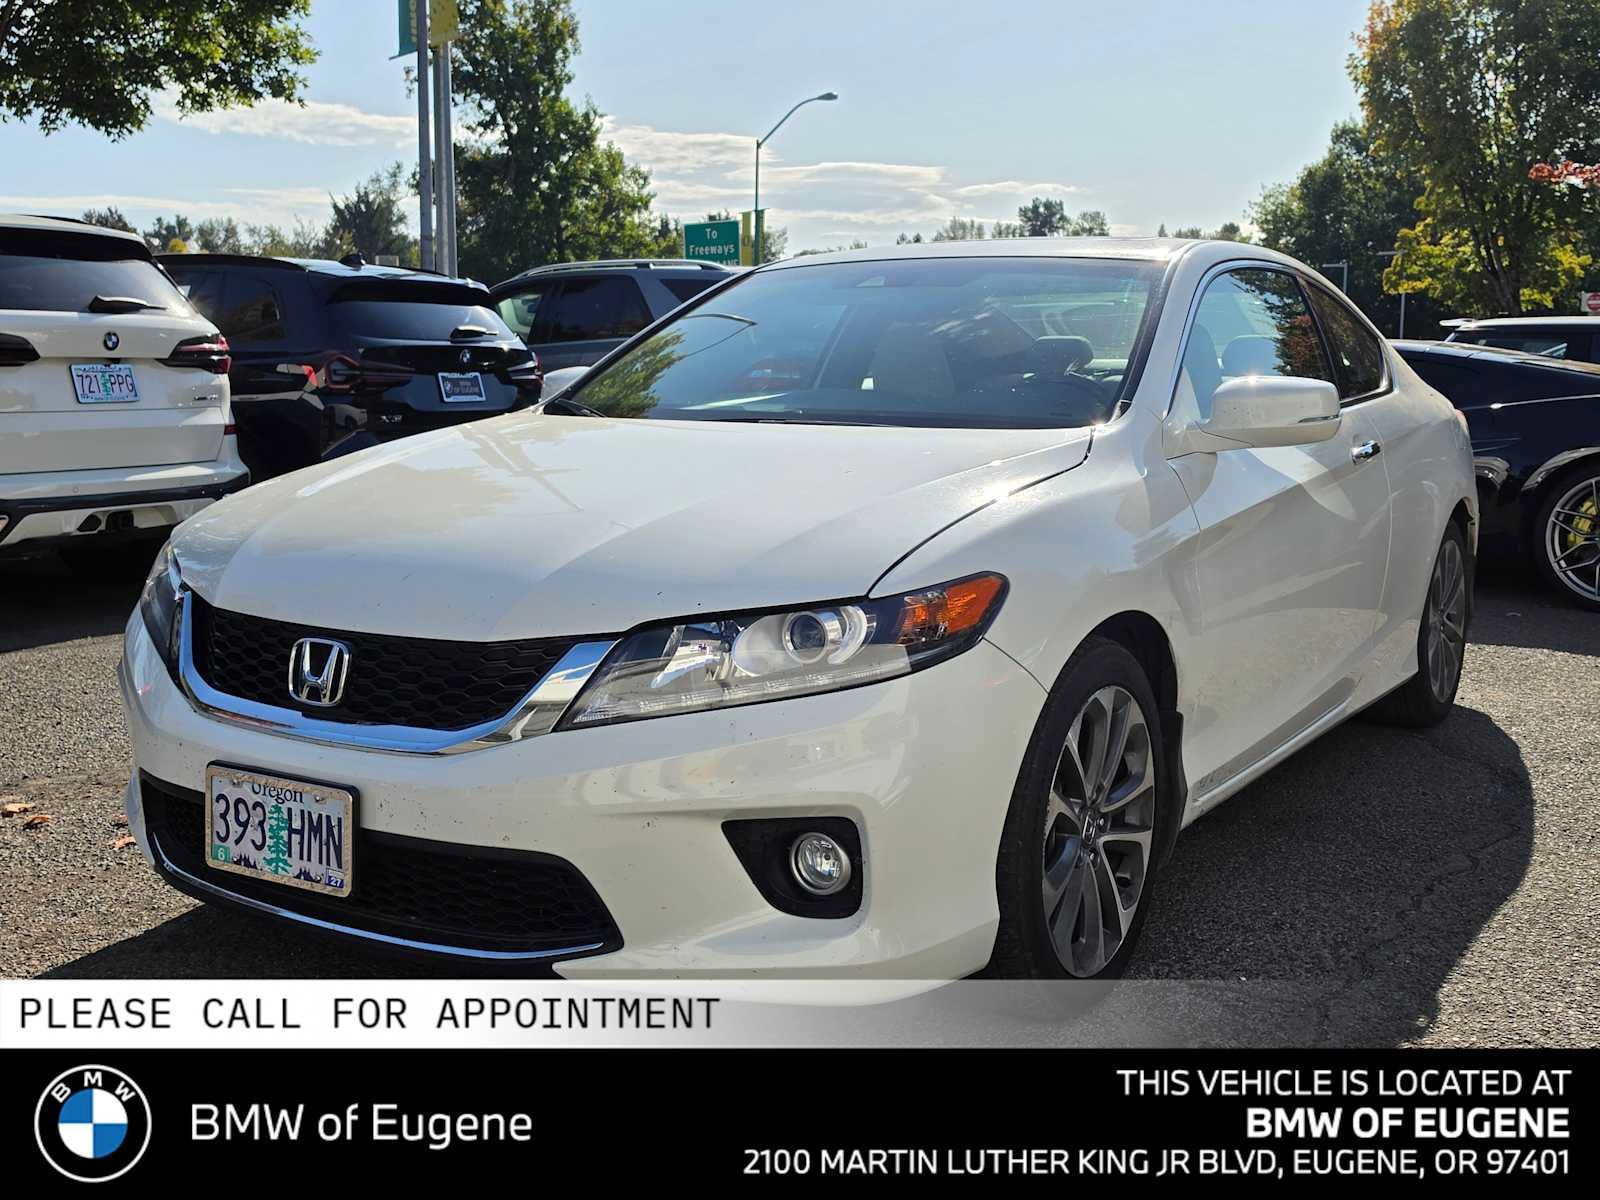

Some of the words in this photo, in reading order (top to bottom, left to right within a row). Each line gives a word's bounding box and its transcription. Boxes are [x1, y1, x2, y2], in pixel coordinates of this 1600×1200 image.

[705, 228, 718, 240] To
[689, 243, 735, 256] Freeways
[76, 374, 101, 394] 721
[108, 374, 134, 393] PPG
[251, 783, 304, 804] Oregon
[215, 793, 267, 851] 393
[287, 807, 343, 870] HMN
[217, 847, 225, 860] 6
